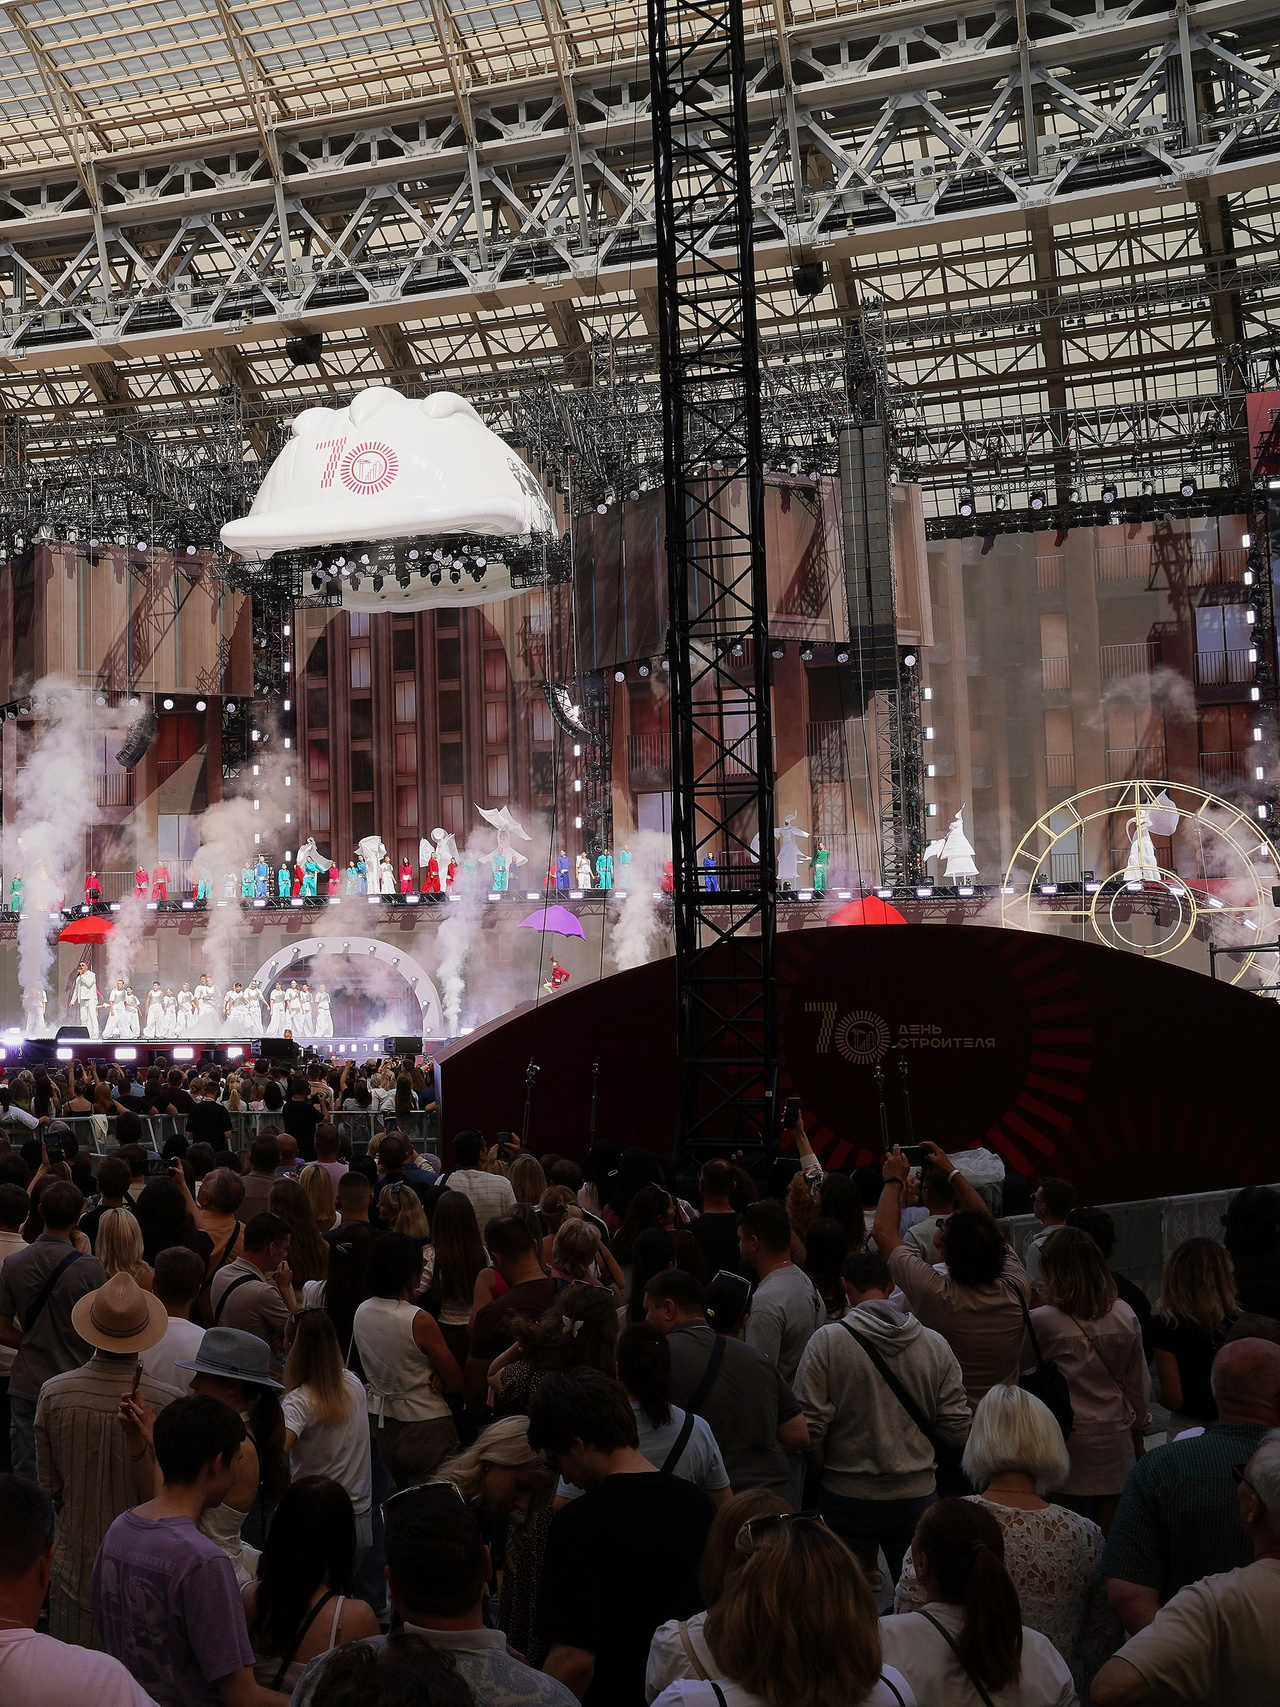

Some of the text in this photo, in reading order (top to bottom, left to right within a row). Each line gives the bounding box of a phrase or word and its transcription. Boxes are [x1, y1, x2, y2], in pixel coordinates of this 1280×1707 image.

[804, 1002, 891, 1065] 70
[897, 1024, 943, 1035] ДЕНЬ
[898, 1037, 996, 1049] СТРОИТЕЛЯ
